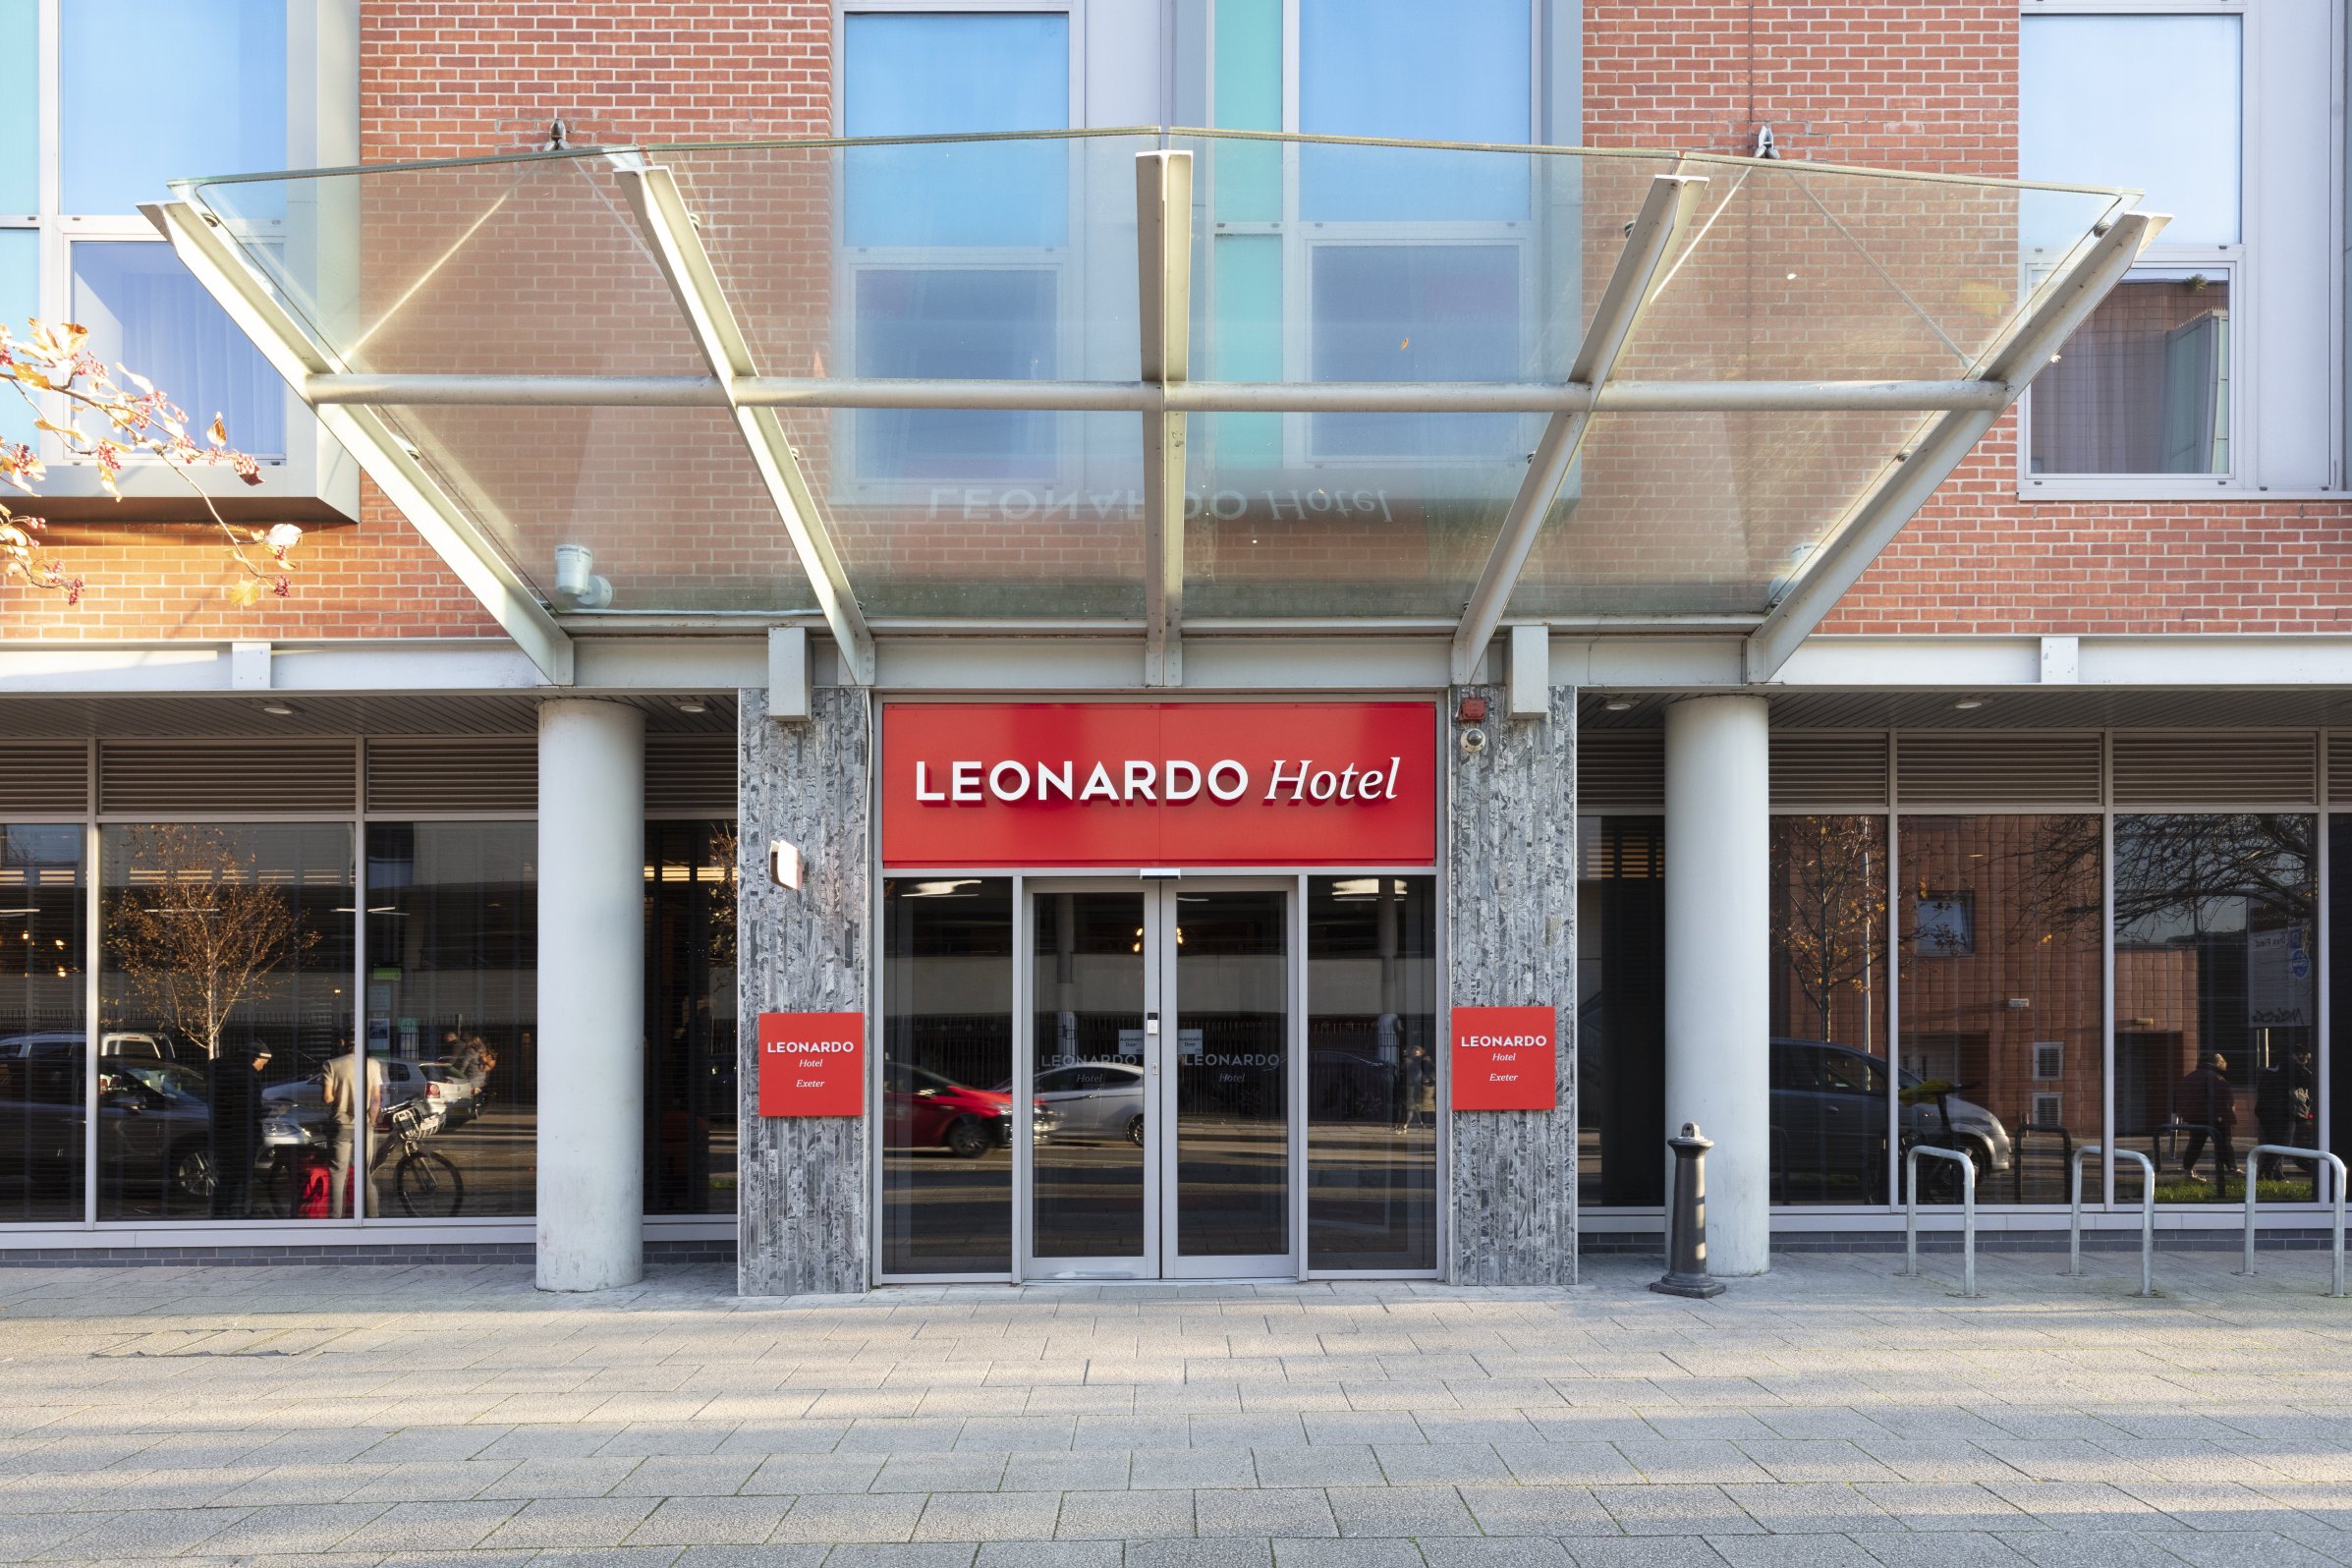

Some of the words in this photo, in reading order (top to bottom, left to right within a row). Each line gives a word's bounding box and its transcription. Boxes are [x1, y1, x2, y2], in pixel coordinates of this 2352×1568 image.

[916, 759, 1249, 802] LEONARDO
[1263, 756, 1401, 801] Hotel
[767, 1041, 854, 1053] LEONARDO
[1461, 1036, 1547, 1047] LEONARDO
[799, 1059, 823, 1068] Hotel
[1041, 1054, 1138, 1067] LEONARDO
[1184, 1053, 1280, 1067] LEONARDO
[1076, 1073, 1103, 1084] Hotel
[1218, 1073, 1246, 1084] Hotel
[1489, 1073, 1519, 1082] Exeter
[796, 1079, 825, 1088] Exeter
